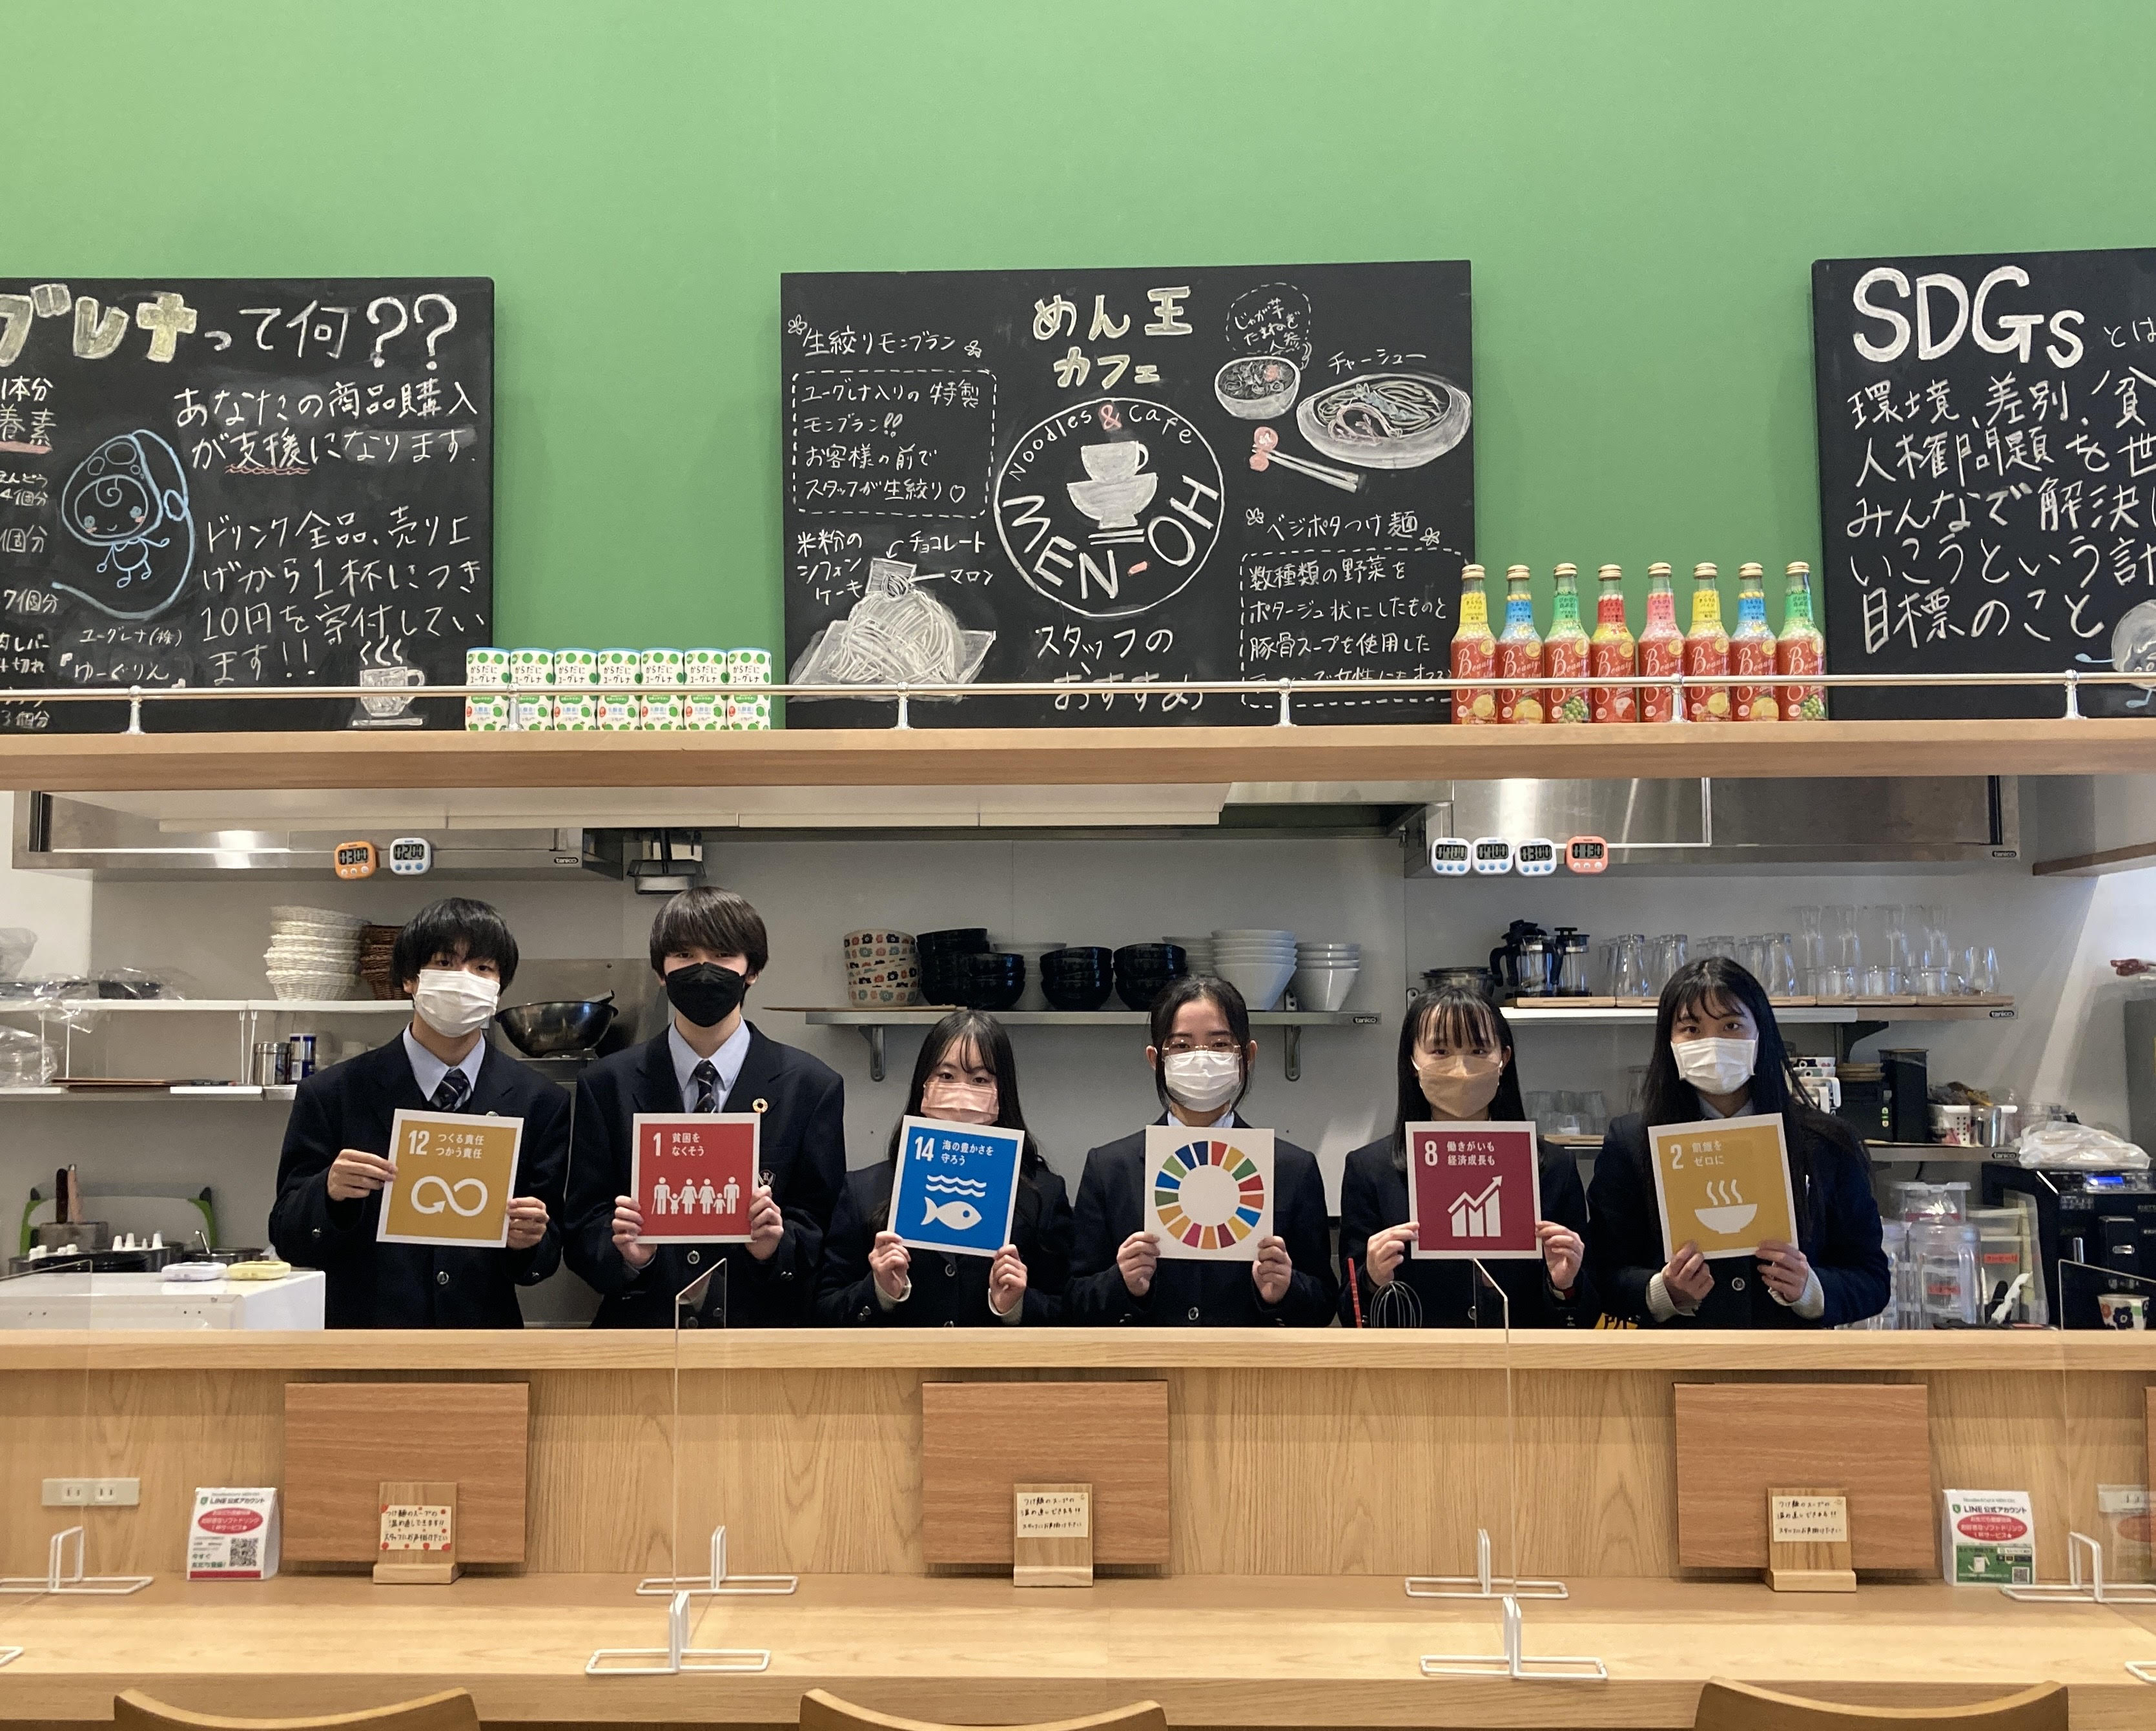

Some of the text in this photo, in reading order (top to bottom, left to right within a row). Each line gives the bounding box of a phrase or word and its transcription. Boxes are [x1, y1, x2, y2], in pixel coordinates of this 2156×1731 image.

[1032, 286, 1193, 342] めん王
[1853, 265, 2085, 369] SDGs
[802, 325, 956, 357] 生絞りモンブラン
[1053, 345, 1161, 390] カフェ
[1328, 348, 1427, 375] チャーシュー
[173, 377, 478, 428] あなたの商品購入
[1009, 409, 1093, 482] Noodles
[1100, 404, 1122, 431] &
[805, 443, 938, 471] お客様の前で
[1266, 510, 1419, 542] ベジポタつけ麺
[797, 529, 863, 557] 米粉の
[909, 530, 986, 553] チョコレート
[202, 557, 481, 600] げから1杯につき
[797, 558, 862, 584] シフォン
[950, 569, 994, 586] マロン
[1249, 555, 1407, 592] 数種類の野菜を
[815, 580, 865, 606] ケーキ
[201, 602, 485, 645] 10円を寄付してい
[1249, 597, 1448, 624] ポタージュ状にしたものと
[1862, 586, 2105, 654] 目標のこと
[1035, 624, 1174, 660] スタッフの
[1249, 631, 1432, 662] 豚骨スープを使用した
[409, 1130, 430, 1156] 12
[437, 1133, 484, 1146] つくる責任
[653, 1132, 662, 1156] 1
[672, 1145, 705, 1156] なくそう
[914, 1136, 936, 1162] 14
[941, 1139, 994, 1156] 海の豊かさを
[1446, 1141, 1495, 1152] 働きがいも
[435, 1147, 482, 1160] つかう責任
[941, 1152, 966, 1166] 守ろう
[1424, 1140, 1439, 1166] 8
[1448, 1154, 1495, 1166] 経済成長も
[1670, 1144, 1684, 1170] 2
[1694, 1154, 1725, 1167] ゼロに
[1964, 1505, 1983, 1513] LINE
